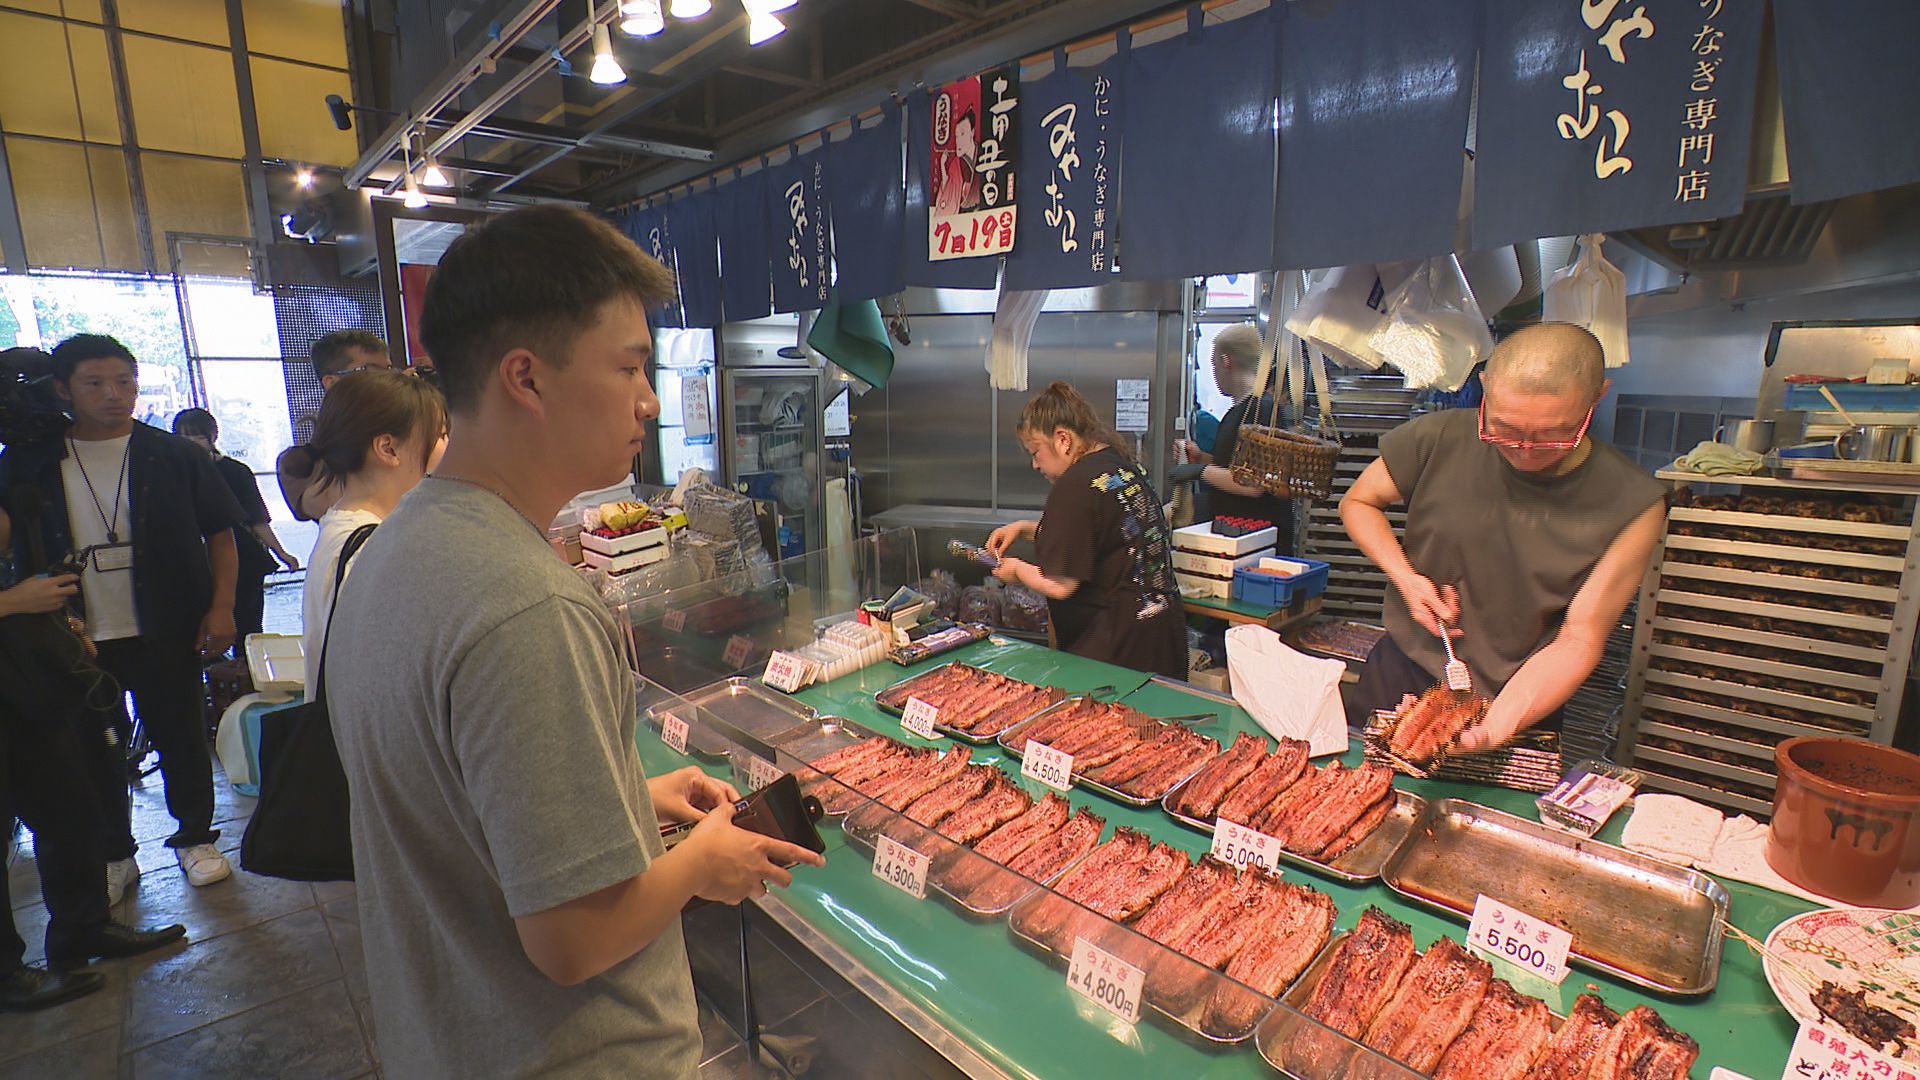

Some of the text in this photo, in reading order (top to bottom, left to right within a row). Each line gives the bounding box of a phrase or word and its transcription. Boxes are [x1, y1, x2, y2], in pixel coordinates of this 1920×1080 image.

[937, 98, 948, 141] うなぎ
[975, 76, 1018, 206] 土用丑の日
[1090, 76, 1110, 272] かに・うなぎ専門店
[1035, 746, 1063, 765] うなぎ
[1032, 760, 1066, 787] 4,500円
[887, 844, 917, 868] うなぎ
[1228, 827, 1267, 850] うなぎ
[884, 860, 921, 895] 4,300円
[1492, 909, 1552, 945] うなぎ
[1087, 951, 1129, 982] うなぎ
[1083, 971, 1134, 1017] 4,800円
